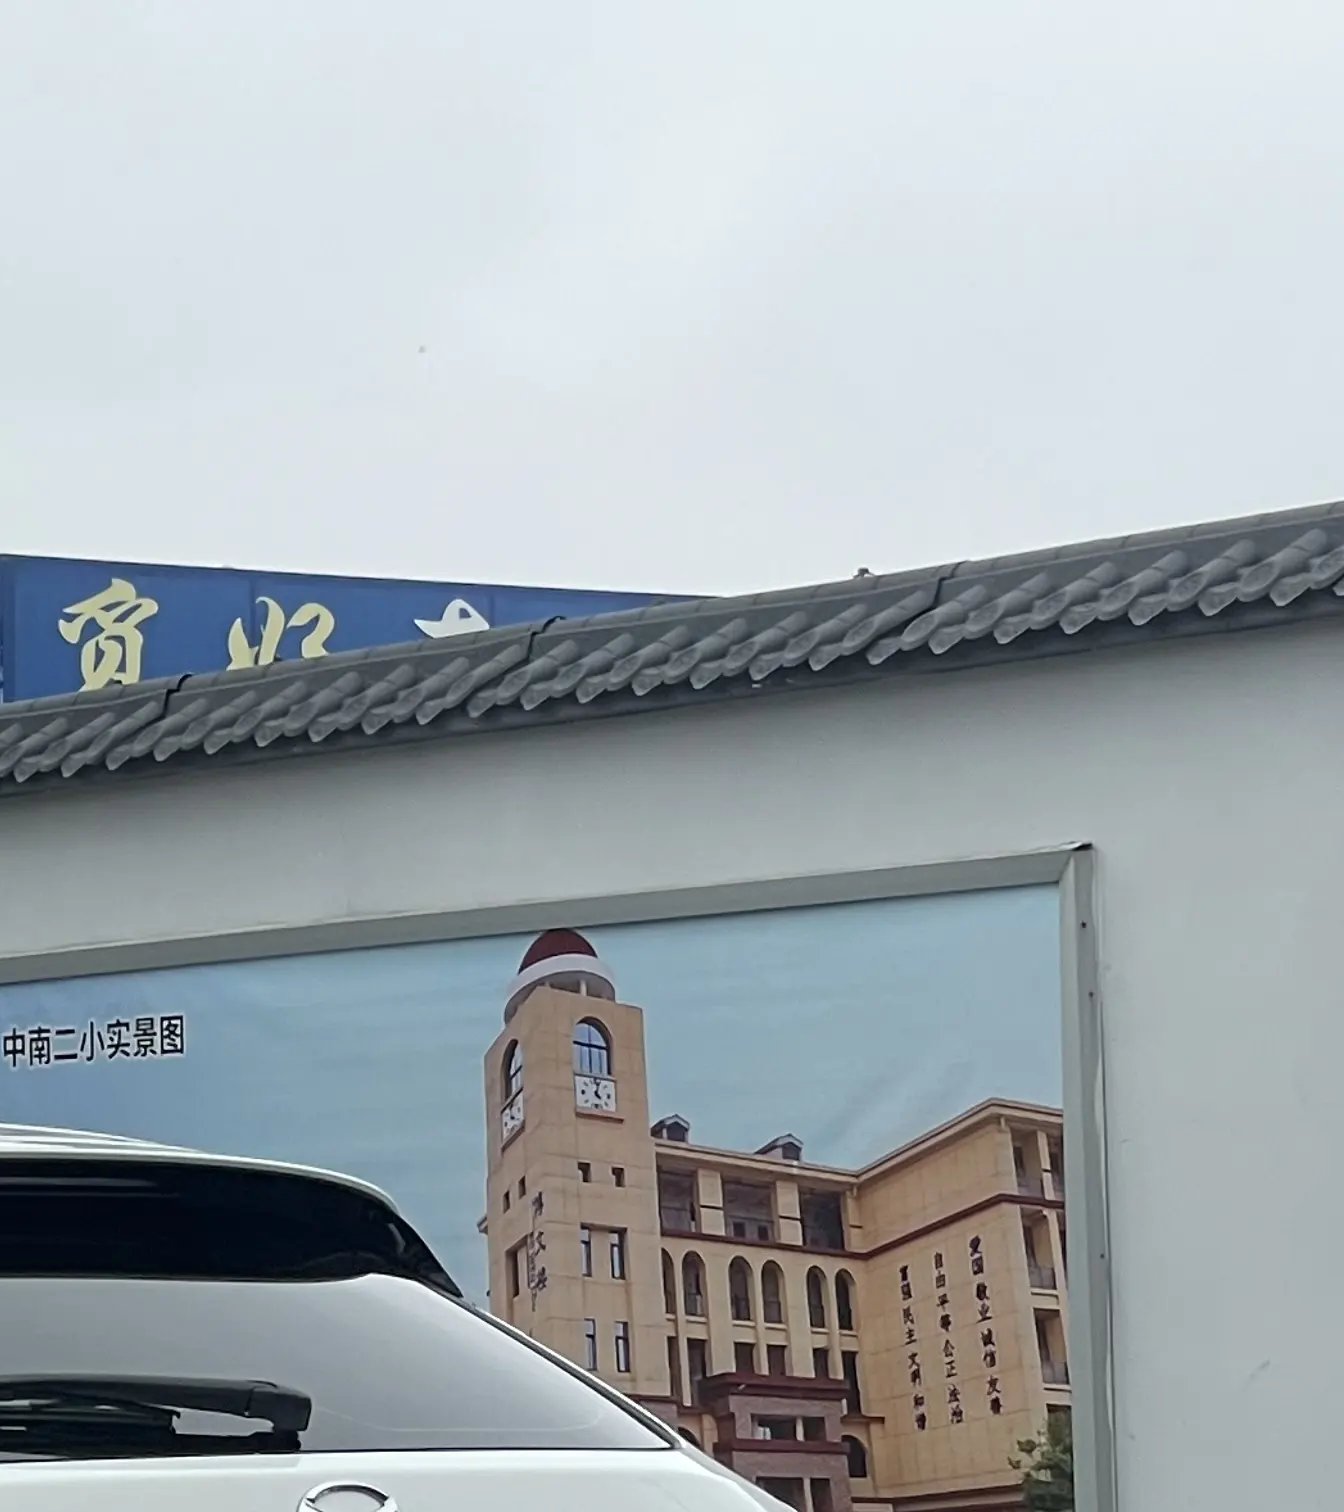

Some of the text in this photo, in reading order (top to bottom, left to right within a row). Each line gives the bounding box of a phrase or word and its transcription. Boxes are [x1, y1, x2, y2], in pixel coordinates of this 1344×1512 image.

[2, 1015, 185, 1068] 中南二小实景图
